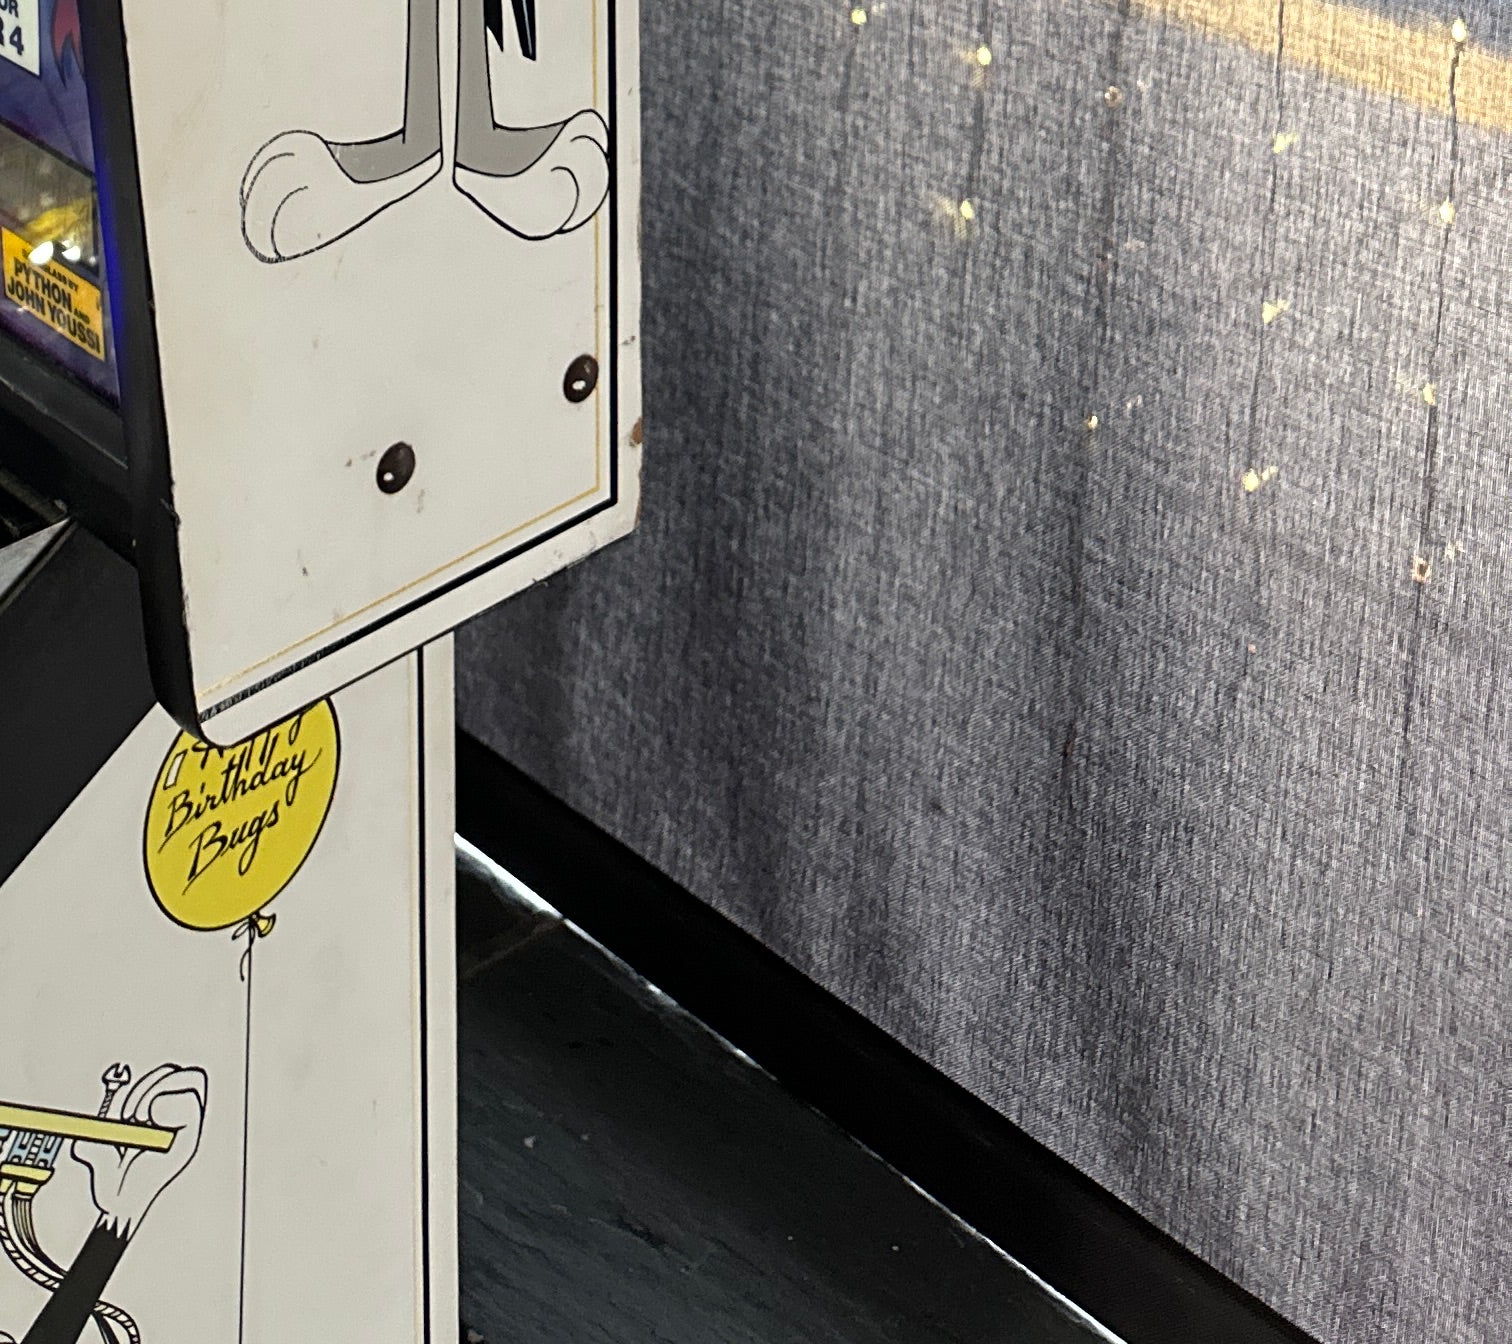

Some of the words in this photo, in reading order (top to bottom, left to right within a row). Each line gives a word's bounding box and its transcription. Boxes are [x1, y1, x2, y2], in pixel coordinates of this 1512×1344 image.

[9, 25, 25, 57] 4
[7, 276, 47, 317] JOHN
[47, 299, 101, 356] YOUSSI
[14, 256, 73, 313] PYTHON
[158, 732, 323, 854] Birthday
[182, 800, 281, 896] Bugs
